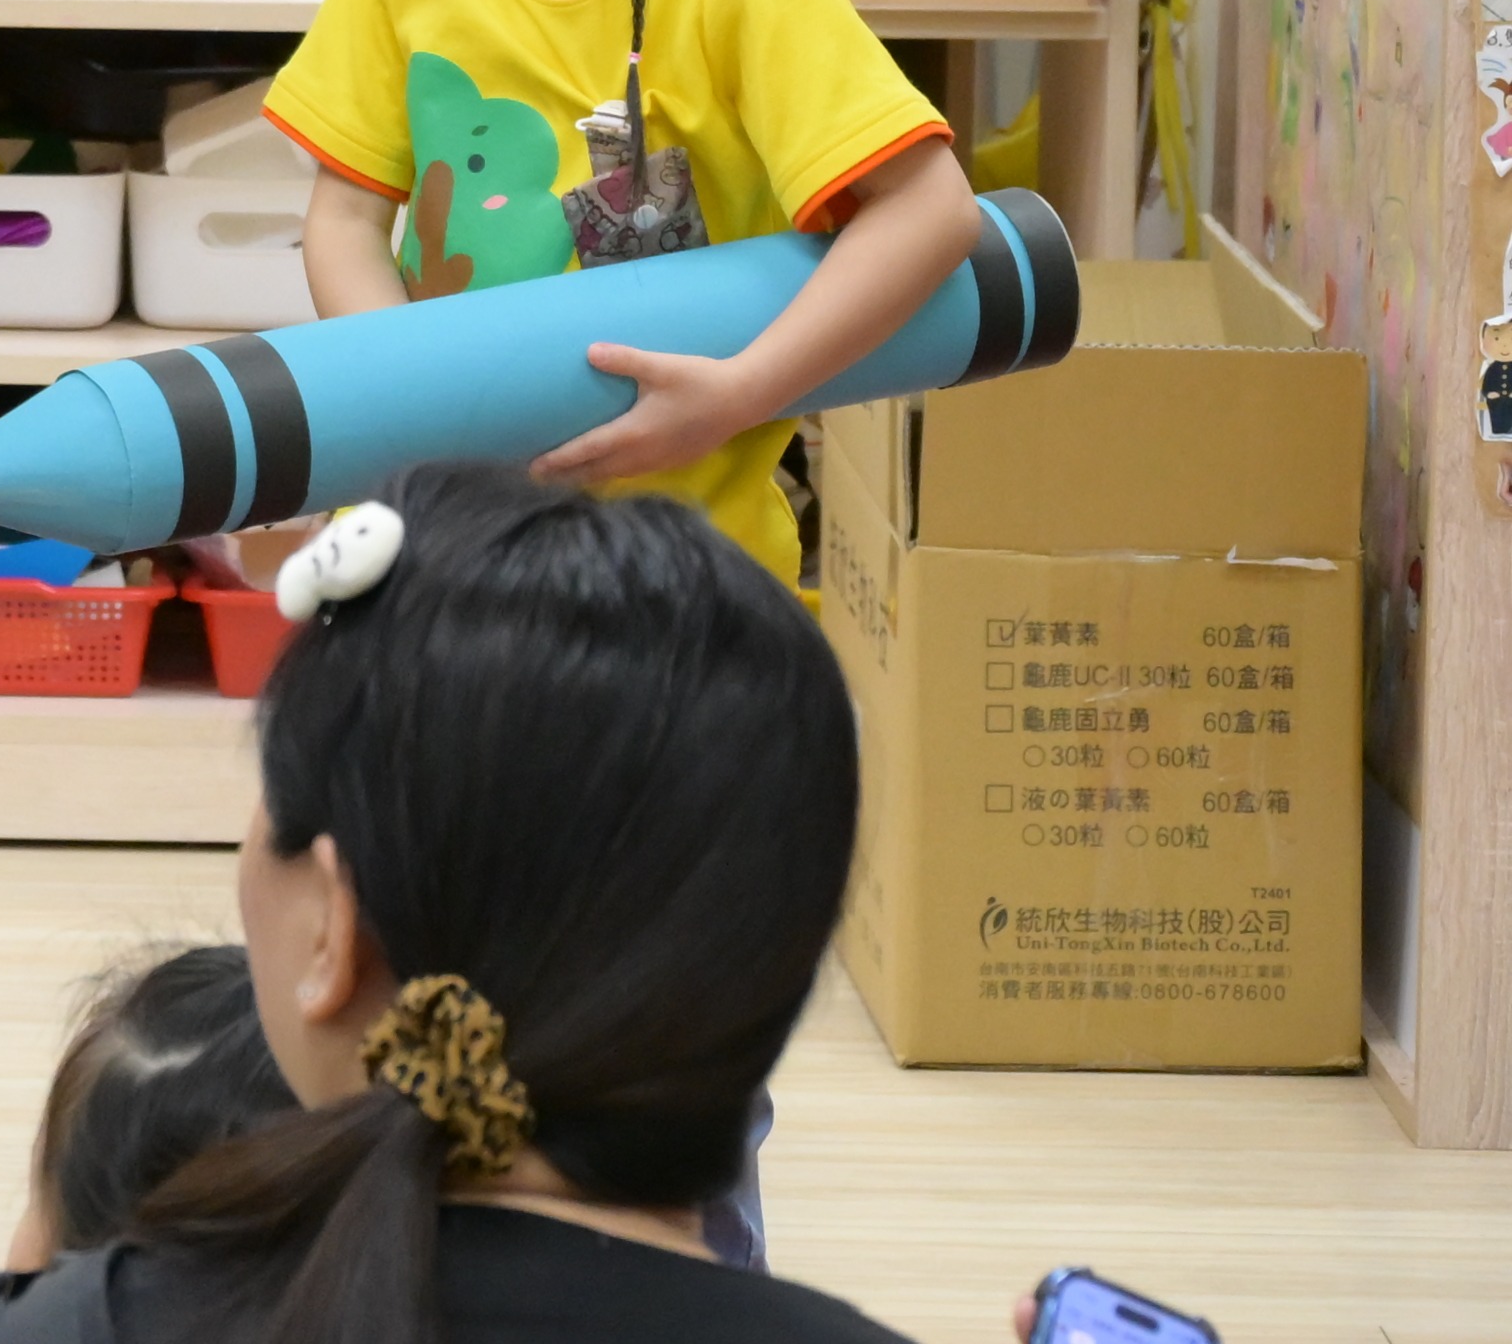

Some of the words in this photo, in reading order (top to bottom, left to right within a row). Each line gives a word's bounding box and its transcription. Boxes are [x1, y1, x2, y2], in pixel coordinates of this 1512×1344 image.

[1023, 621, 1100, 648] 葉黃素
[1202, 623, 1291, 649] 60盒/箱
[1139, 664, 1192, 690] 30粒
[1206, 664, 1295, 691] 60盒/箱
[1203, 709, 1291, 735] 60盒/箱
[1050, 744, 1105, 769] 30粒
[1156, 745, 1211, 770] 60粒
[1202, 788, 1291, 815] 60盒/箱
[1049, 823, 1104, 849] 30粒
[1156, 825, 1211, 850] 60粒
[1250, 887, 1292, 900] T2401
[1015, 907, 1291, 935] 統欣生物科技(股)公司
[1016, 936, 1135, 954] Uni-TongXin
[1141, 937, 1210, 953] Biotech
[1216, 937, 1291, 954] Co.,Ltd.
